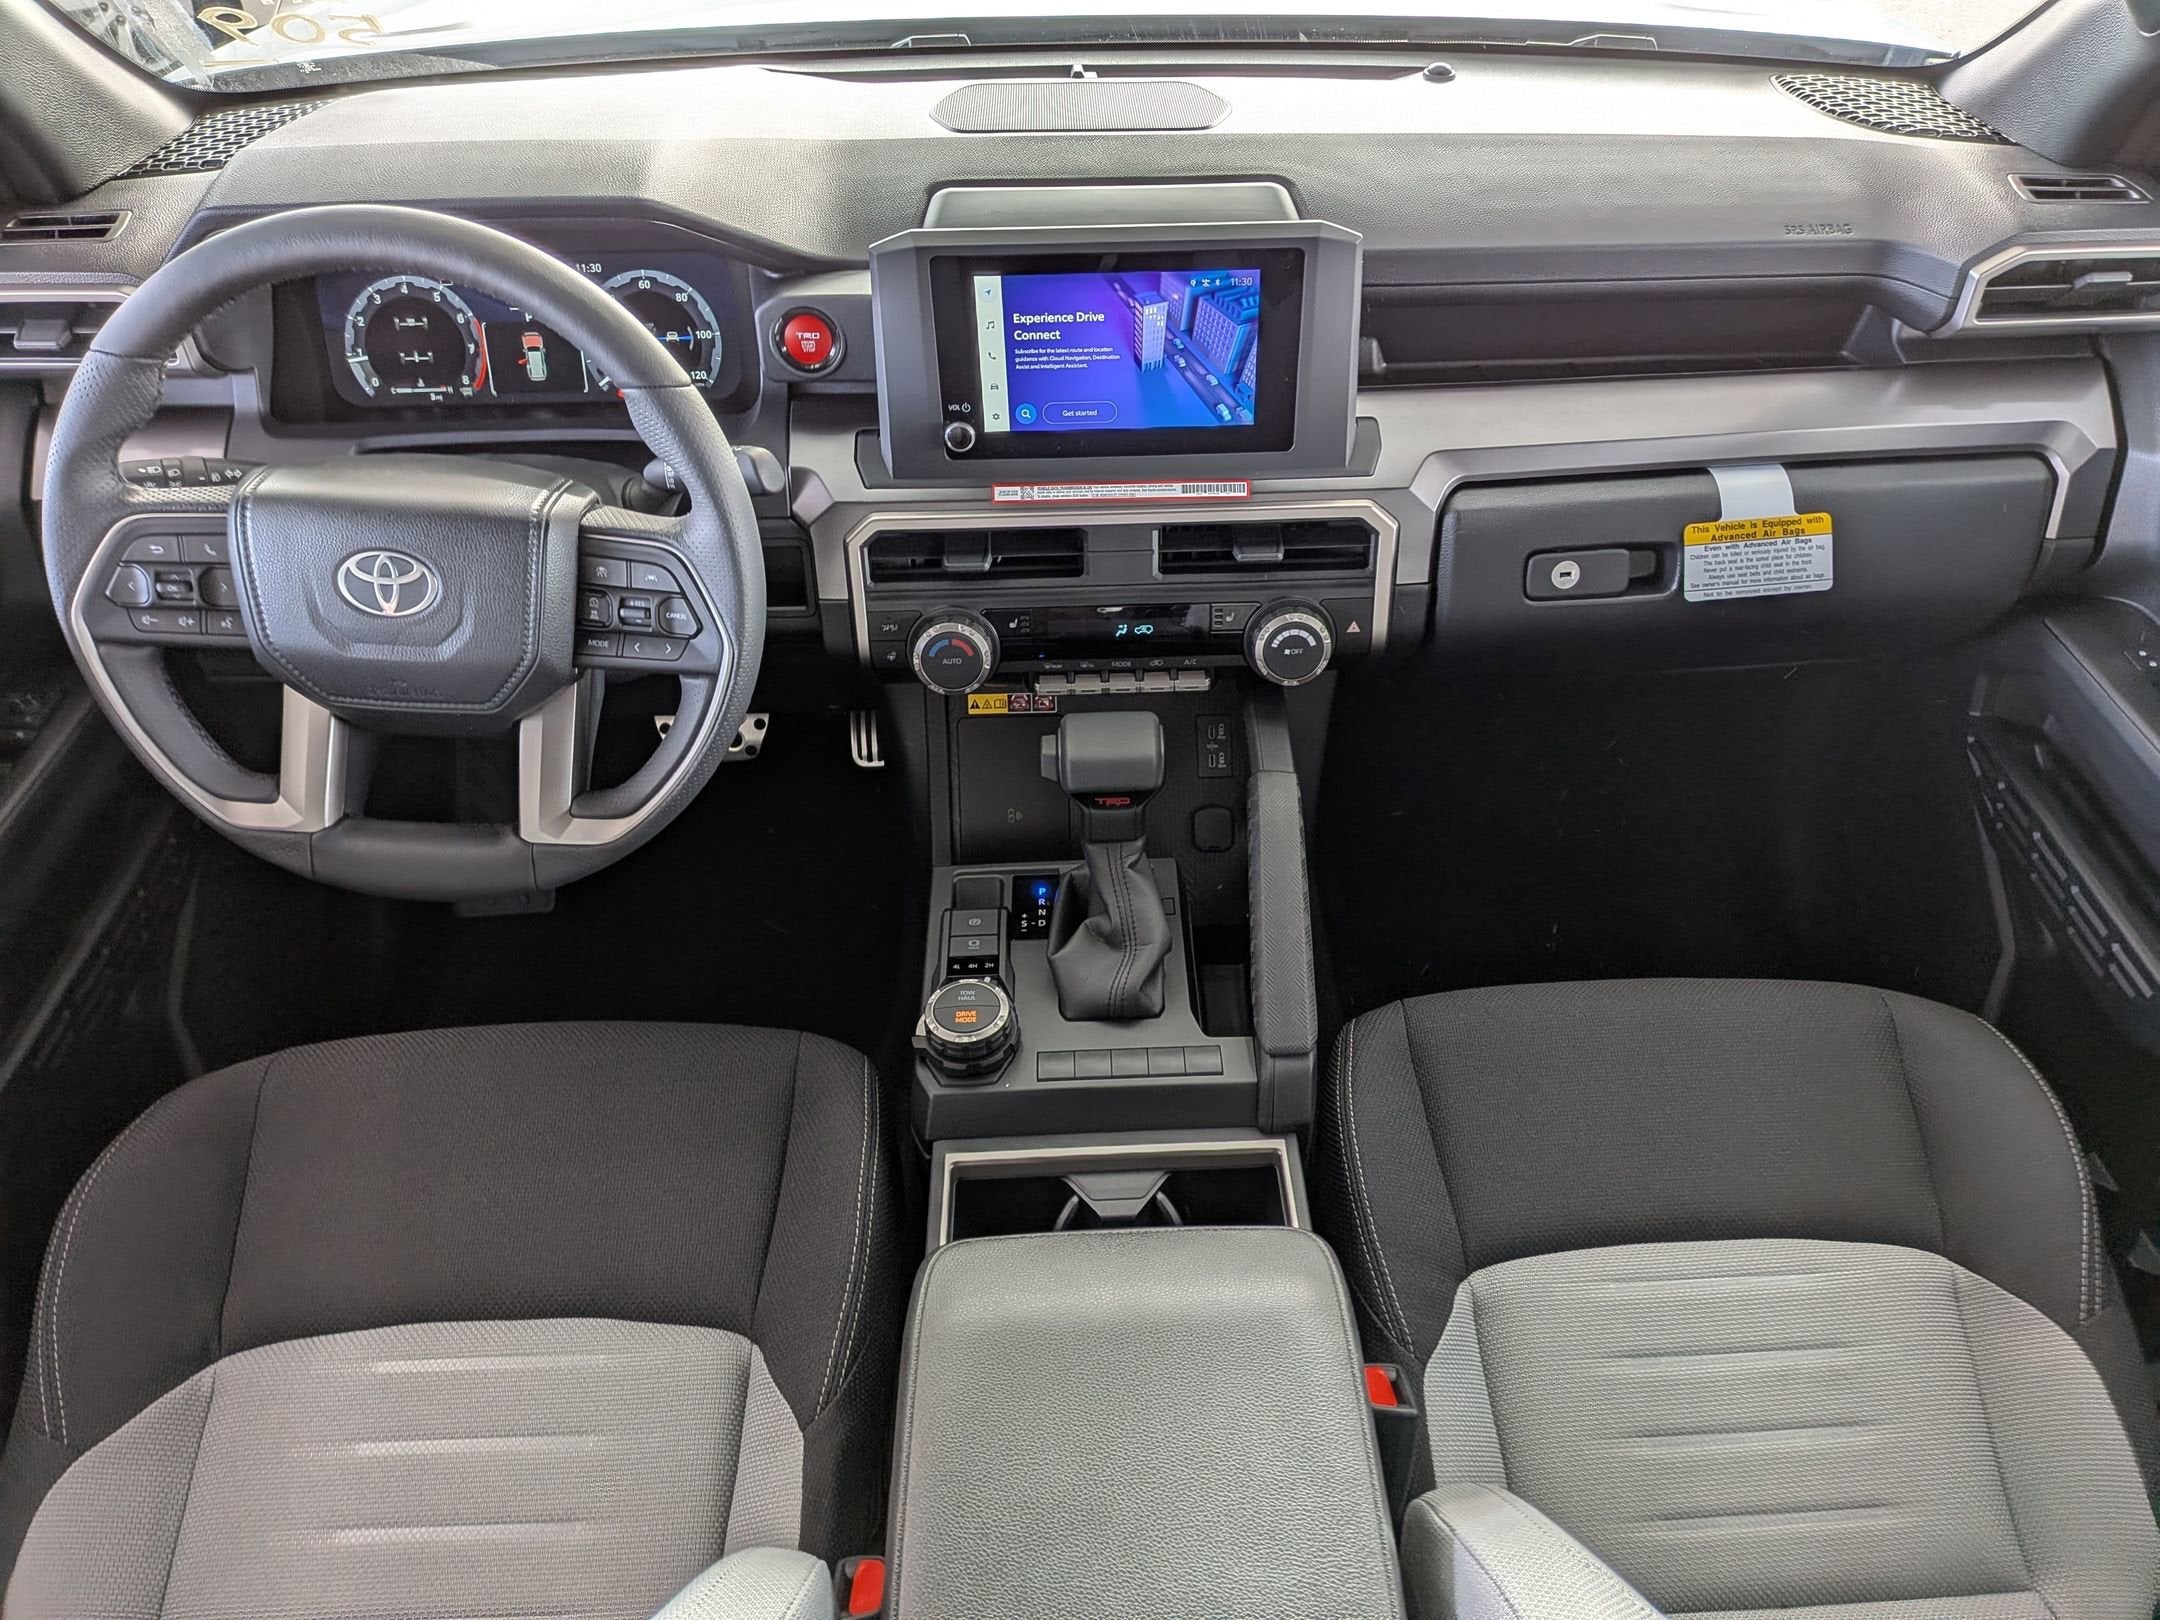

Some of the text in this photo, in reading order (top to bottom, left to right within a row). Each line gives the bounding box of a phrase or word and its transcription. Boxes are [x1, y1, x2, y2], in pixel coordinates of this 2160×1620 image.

[576, 264, 602, 273] 11:30
[638, 280, 651, 289] 60
[1230, 278, 1253, 286] 11:30
[676, 293, 688, 302] 80
[1013, 312, 1105, 325] Experience Drive
[695, 331, 712, 340] 100
[1014, 330, 1061, 341] Connect
[691, 371, 707, 380] 120
[1075, 409, 1097, 417] started
[1692, 526, 1710, 534] This
[1715, 523, 1746, 532] Vehicle
[1763, 518, 1802, 528] Equipped
[1807, 516, 1824, 524] with
[1711, 531, 1757, 542] Advanced
[1783, 528, 1806, 536] Bags
[1744, 540, 1778, 549] Advanced
[666, 612, 687, 620] CANCEL
[588, 640, 609, 648] MODE
[1184, 658, 1197, 666] A/C
[1095, 798, 1130, 806] TRD
[1039, 888, 1046, 896] P
[1039, 898, 1046, 906] R
